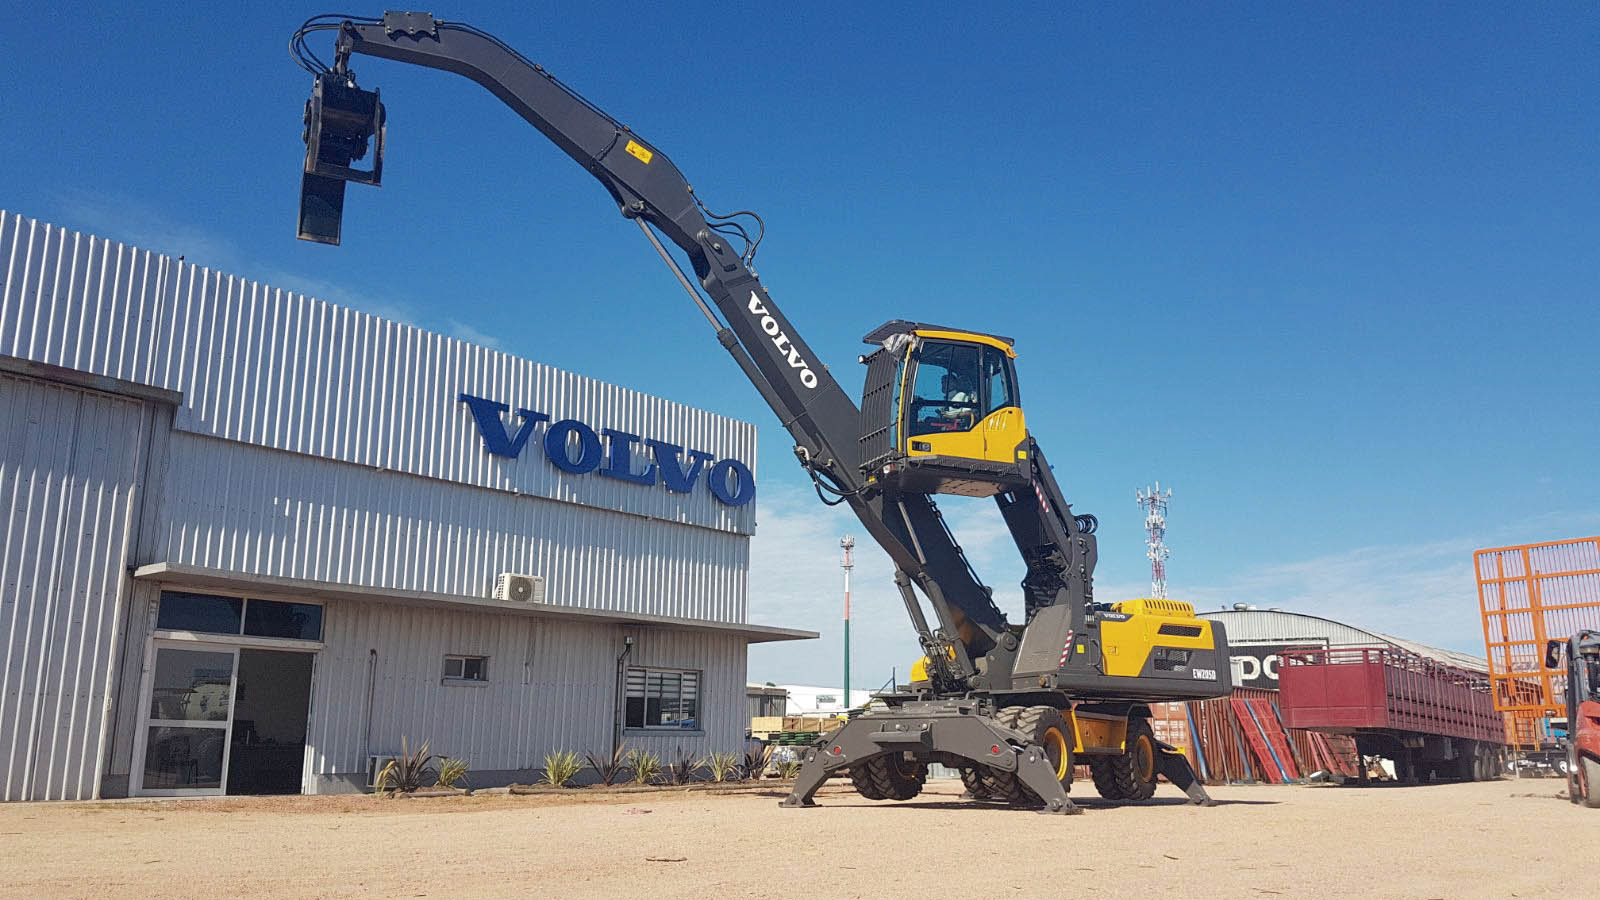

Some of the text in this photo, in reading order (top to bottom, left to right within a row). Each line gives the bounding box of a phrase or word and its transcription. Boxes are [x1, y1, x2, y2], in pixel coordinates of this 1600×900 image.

[748, 290, 818, 389] VOLVO
[459, 393, 757, 507] VOLVO
[1103, 612, 1126, 620] VOLVO
